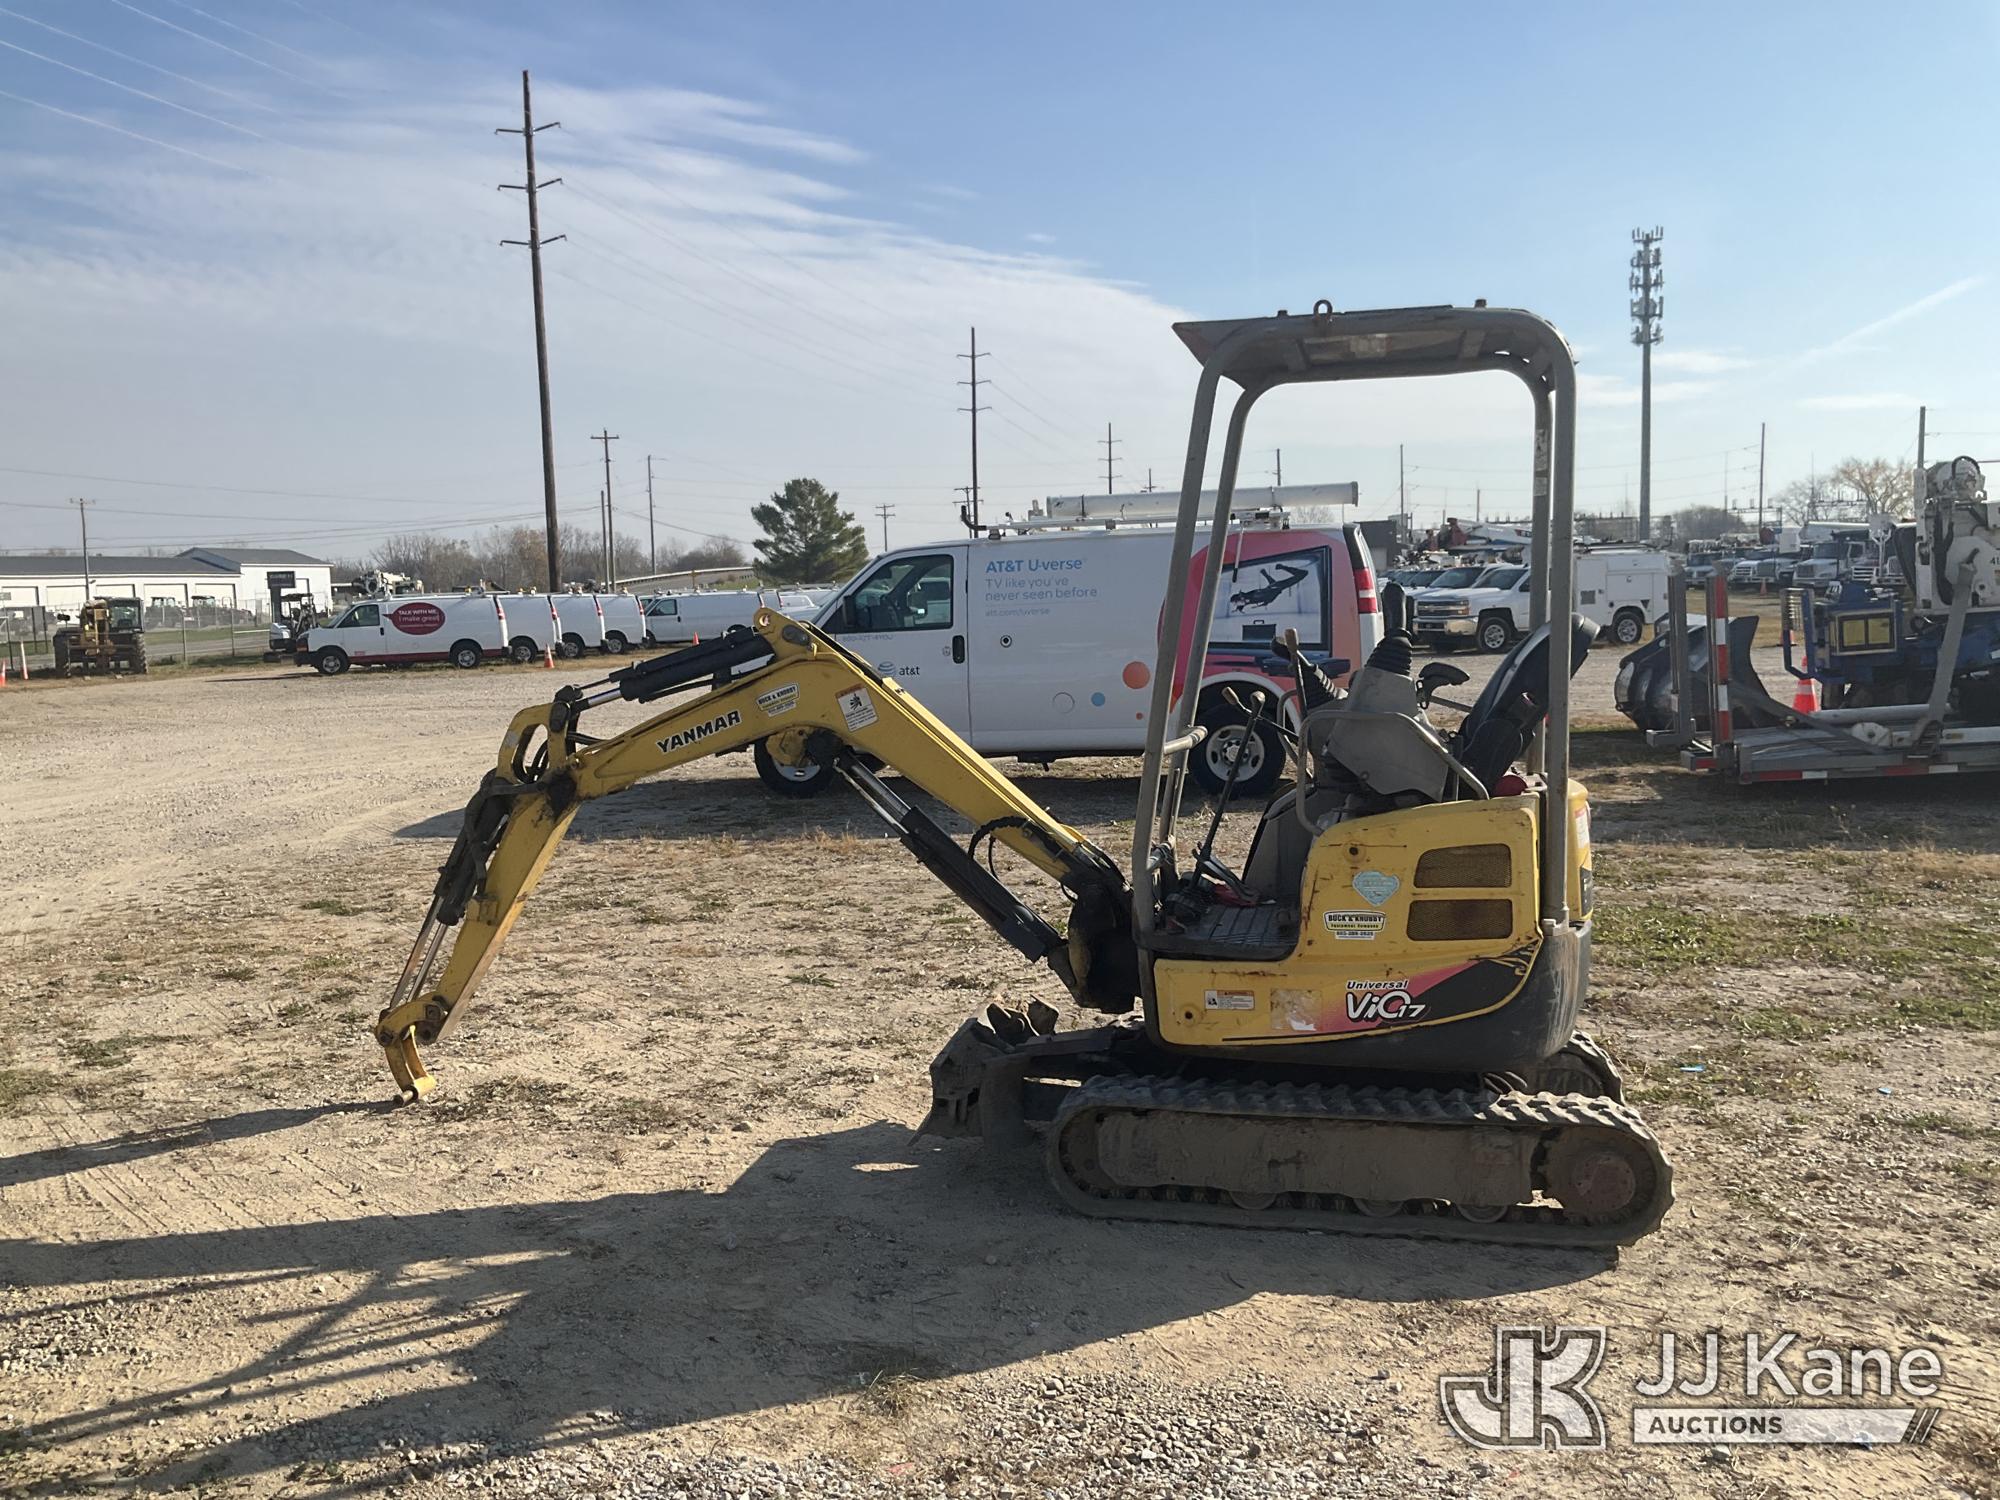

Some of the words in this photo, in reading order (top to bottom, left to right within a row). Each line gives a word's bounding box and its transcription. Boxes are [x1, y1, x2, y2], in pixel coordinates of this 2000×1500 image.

[985, 560, 1024, 573] AT&T
[985, 578, 1002, 589] TV
[1005, 577, 1025, 588] like
[985, 591, 1019, 601] never
[1022, 590, 1053, 600] seen
[1055, 586, 1097, 599] before
[899, 665, 920, 676] at&t
[656, 709, 742, 753] YANMAR
[1346, 980, 1409, 989] Universal
